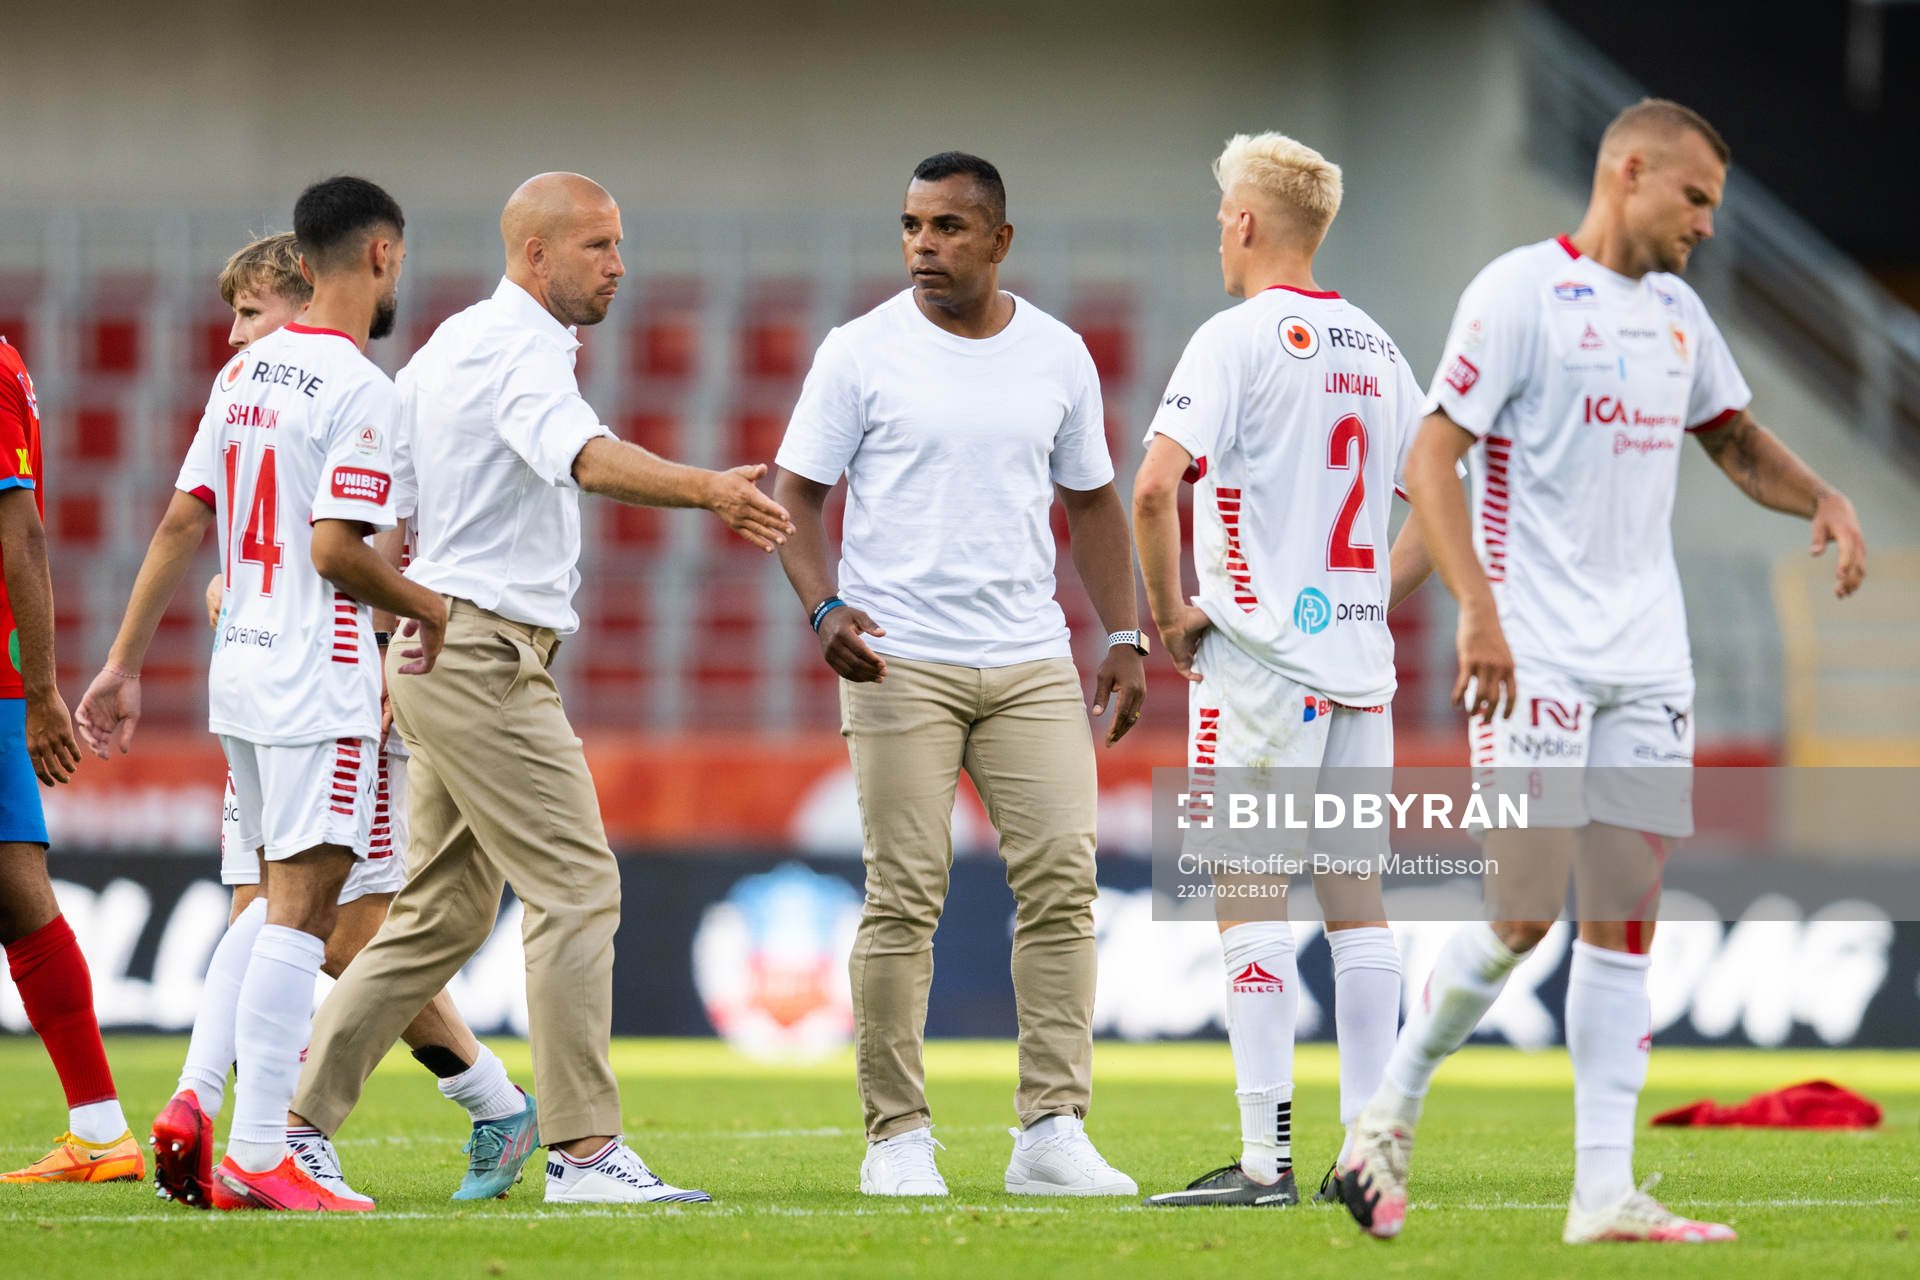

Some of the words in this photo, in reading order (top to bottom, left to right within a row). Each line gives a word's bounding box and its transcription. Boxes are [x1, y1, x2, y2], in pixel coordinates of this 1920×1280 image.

[1327, 327, 1396, 363] REDEYE
[251, 360, 324, 398] REDEYE
[1324, 372, 1382, 397] LINDAHL
[1584, 396, 1627, 424] ICA
[335, 472, 388, 493] UNIBET
[1326, 412, 1377, 573] 2
[222, 439, 284, 598] 14
[1233, 985, 1284, 994] SELECT
